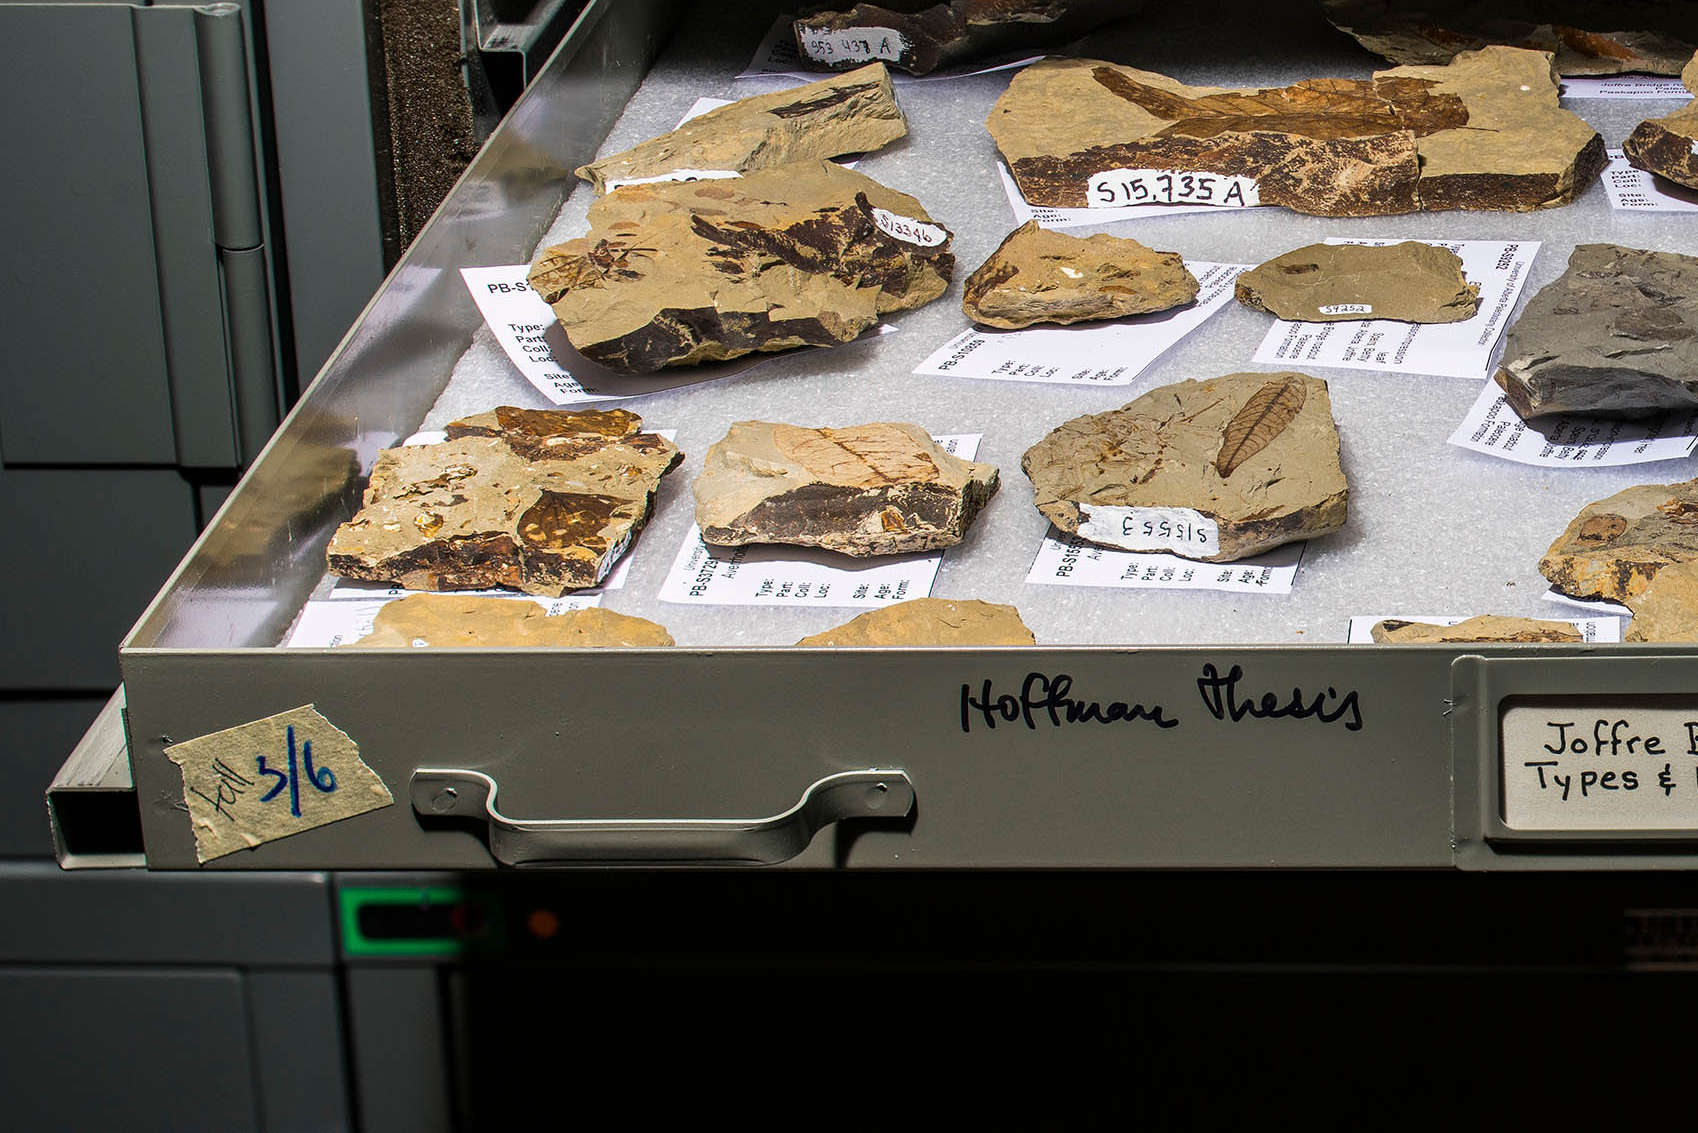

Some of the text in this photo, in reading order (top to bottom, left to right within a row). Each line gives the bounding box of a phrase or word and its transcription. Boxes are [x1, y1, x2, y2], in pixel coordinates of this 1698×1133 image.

[508, 323, 545, 334] Type:
[755, 577, 776, 599] Type:
[776, 579, 794, 599] Part:
[794, 580, 813, 599] Coll:
[813, 582, 832, 599] Loc:
[852, 582, 871, 600] Site:
[873, 582, 891, 600] Age:
[892, 579, 911, 601] Form:
[960, 663, 1364, 732] Hoffman Thesis
[1543, 718, 1666, 757] Joffre
[255, 723, 339, 819] 3/6
[1523, 760, 1640, 801] Types
